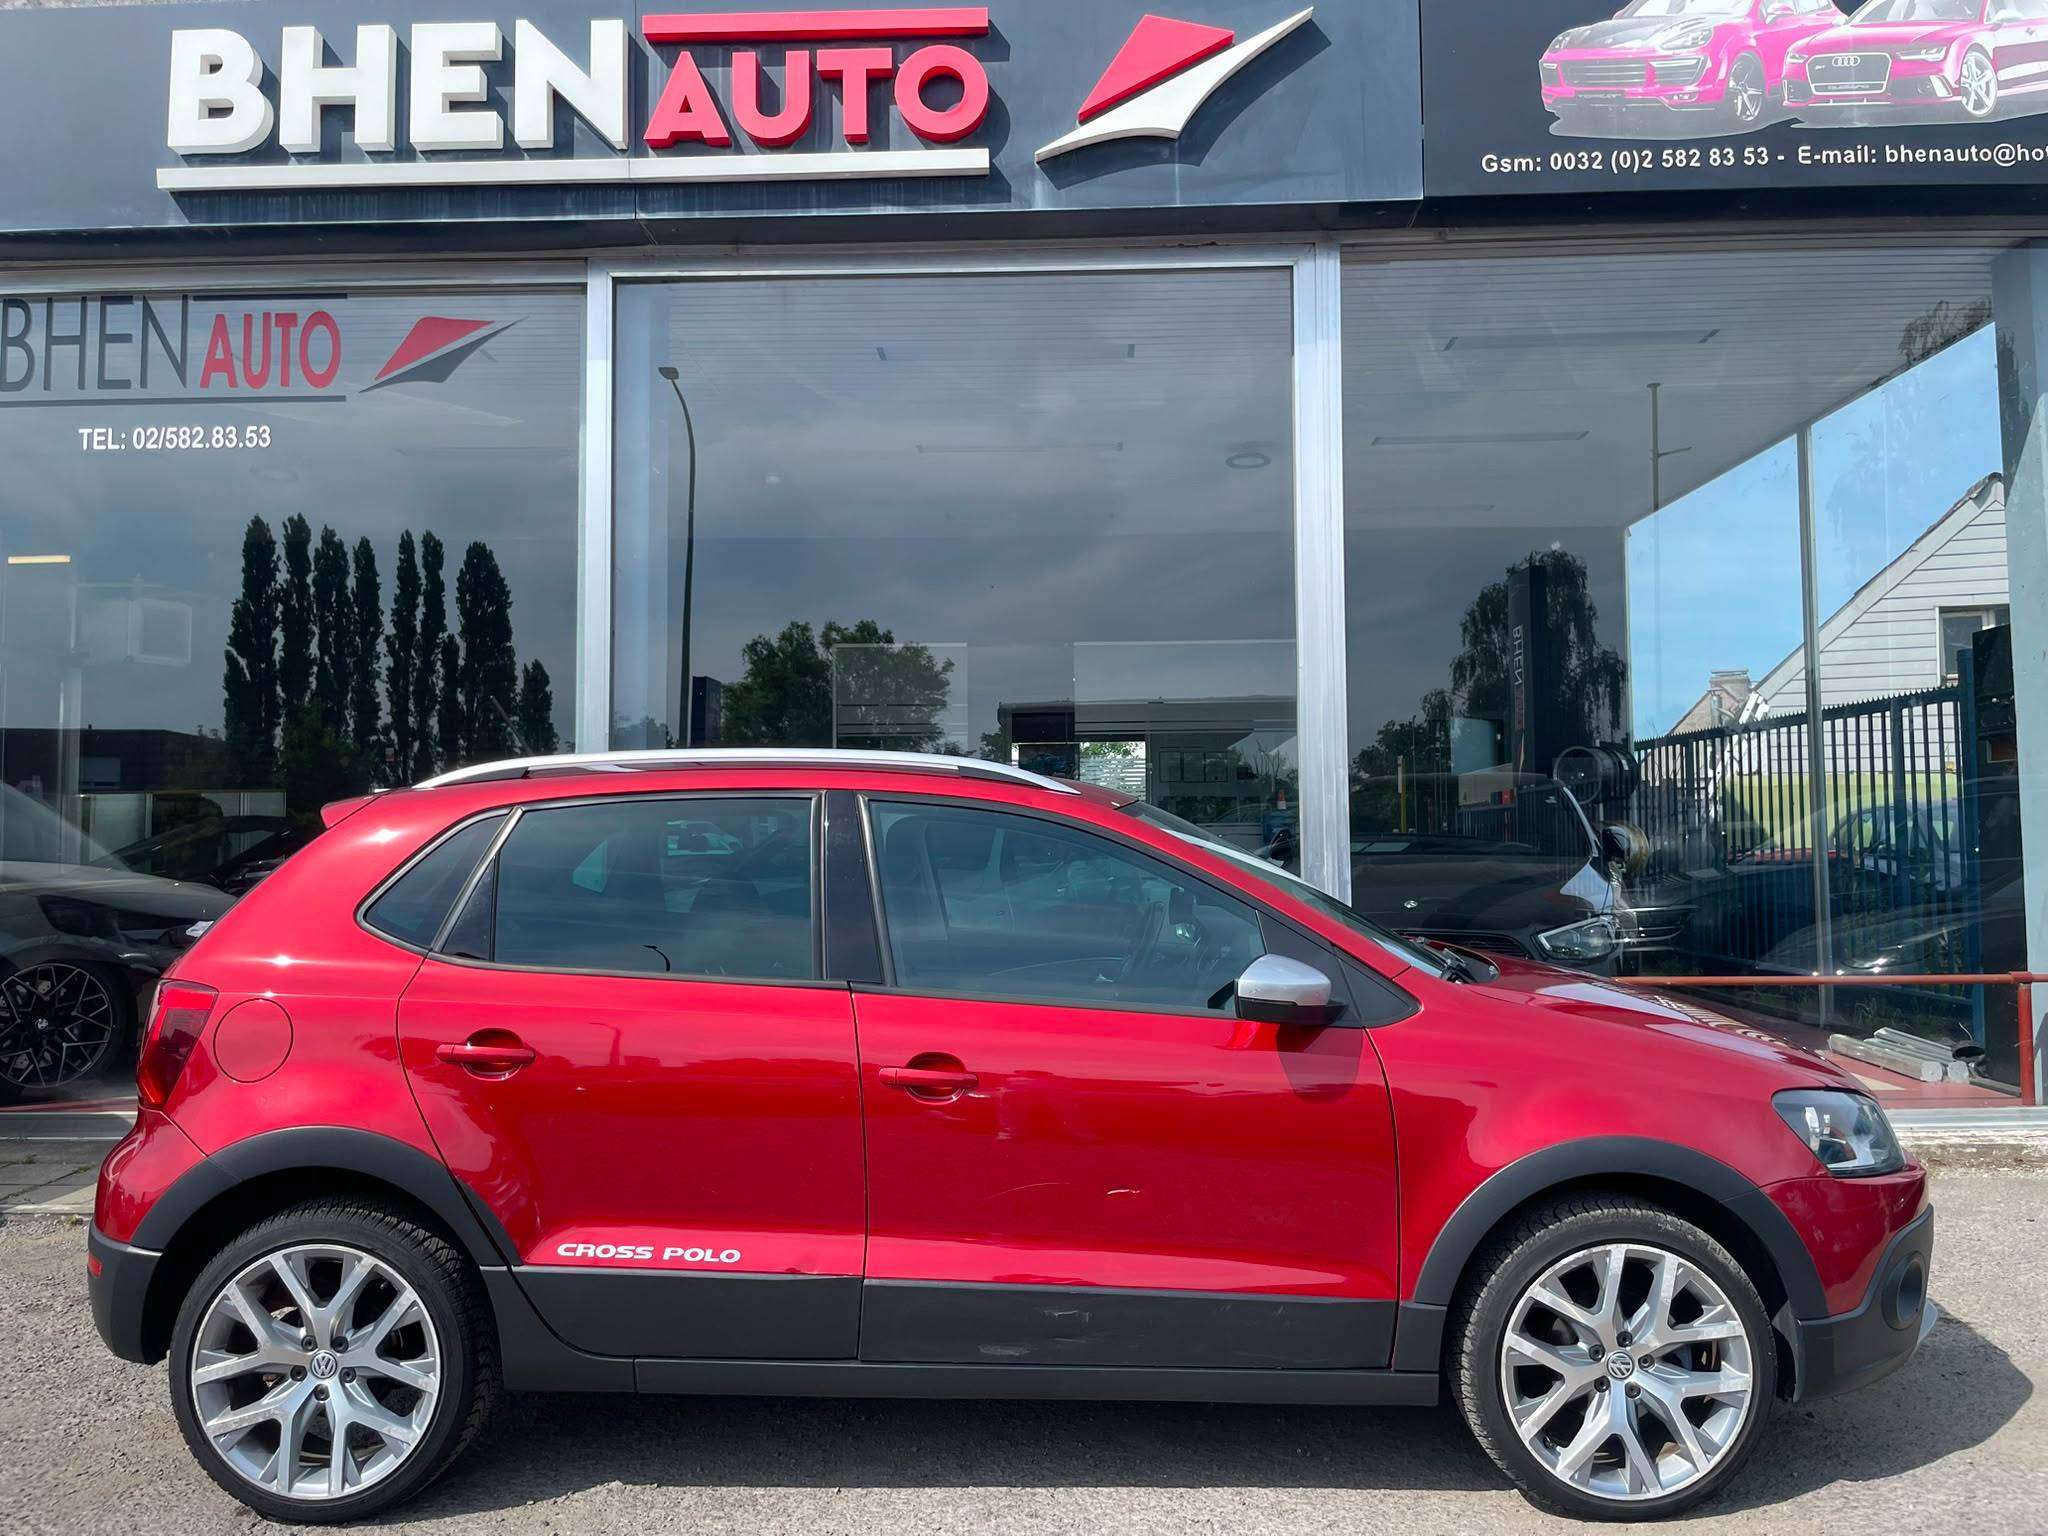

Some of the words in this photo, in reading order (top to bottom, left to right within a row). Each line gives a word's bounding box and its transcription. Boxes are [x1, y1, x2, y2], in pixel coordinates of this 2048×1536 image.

[167, 19, 629, 155] BHEN
[643, 44, 989, 149] AUTO
[1481, 154, 1543, 173] Gsm:
[1550, 151, 1603, 170] 0032
[1611, 149, 1653, 174] (0)2
[1661, 149, 1701, 168] 582
[1709, 147, 1735, 166] 83
[1743, 147, 1769, 166] 53
[1798, 145, 1877, 165] E-mail:
[1885, 143, 2048, 167] bhenauto@ho
[0, 294, 188, 392] BHEN
[200, 310, 341, 389] AUTO
[78, 428, 126, 450] TEL:
[132, 425, 271, 449] 02/582.83.53
[557, 1243, 654, 1259] CROSS
[663, 1247, 741, 1263] POLO
